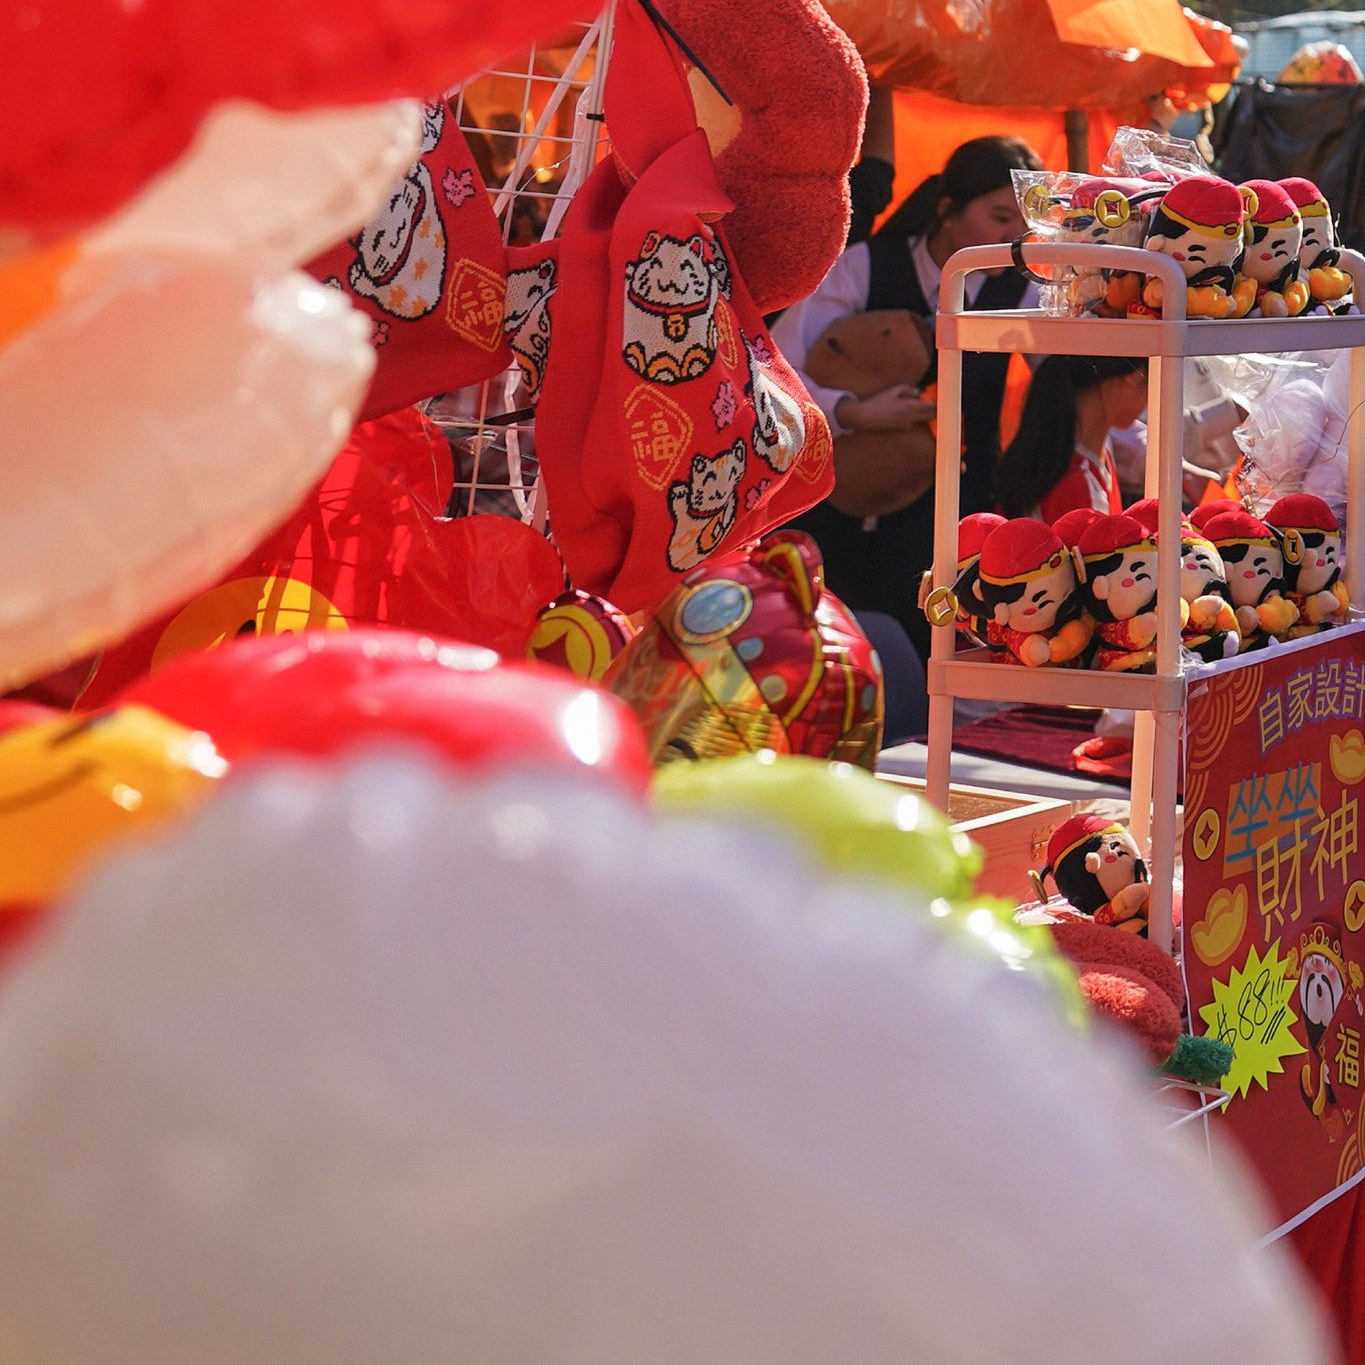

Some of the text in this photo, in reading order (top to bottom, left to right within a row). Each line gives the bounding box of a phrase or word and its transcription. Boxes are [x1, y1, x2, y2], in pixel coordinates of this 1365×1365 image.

[631, 411, 677, 463] 福
[1226, 762, 1319, 863] 坐坐
[1256, 789, 1359, 942] 財神
[1335, 1022, 1361, 1088] 福
